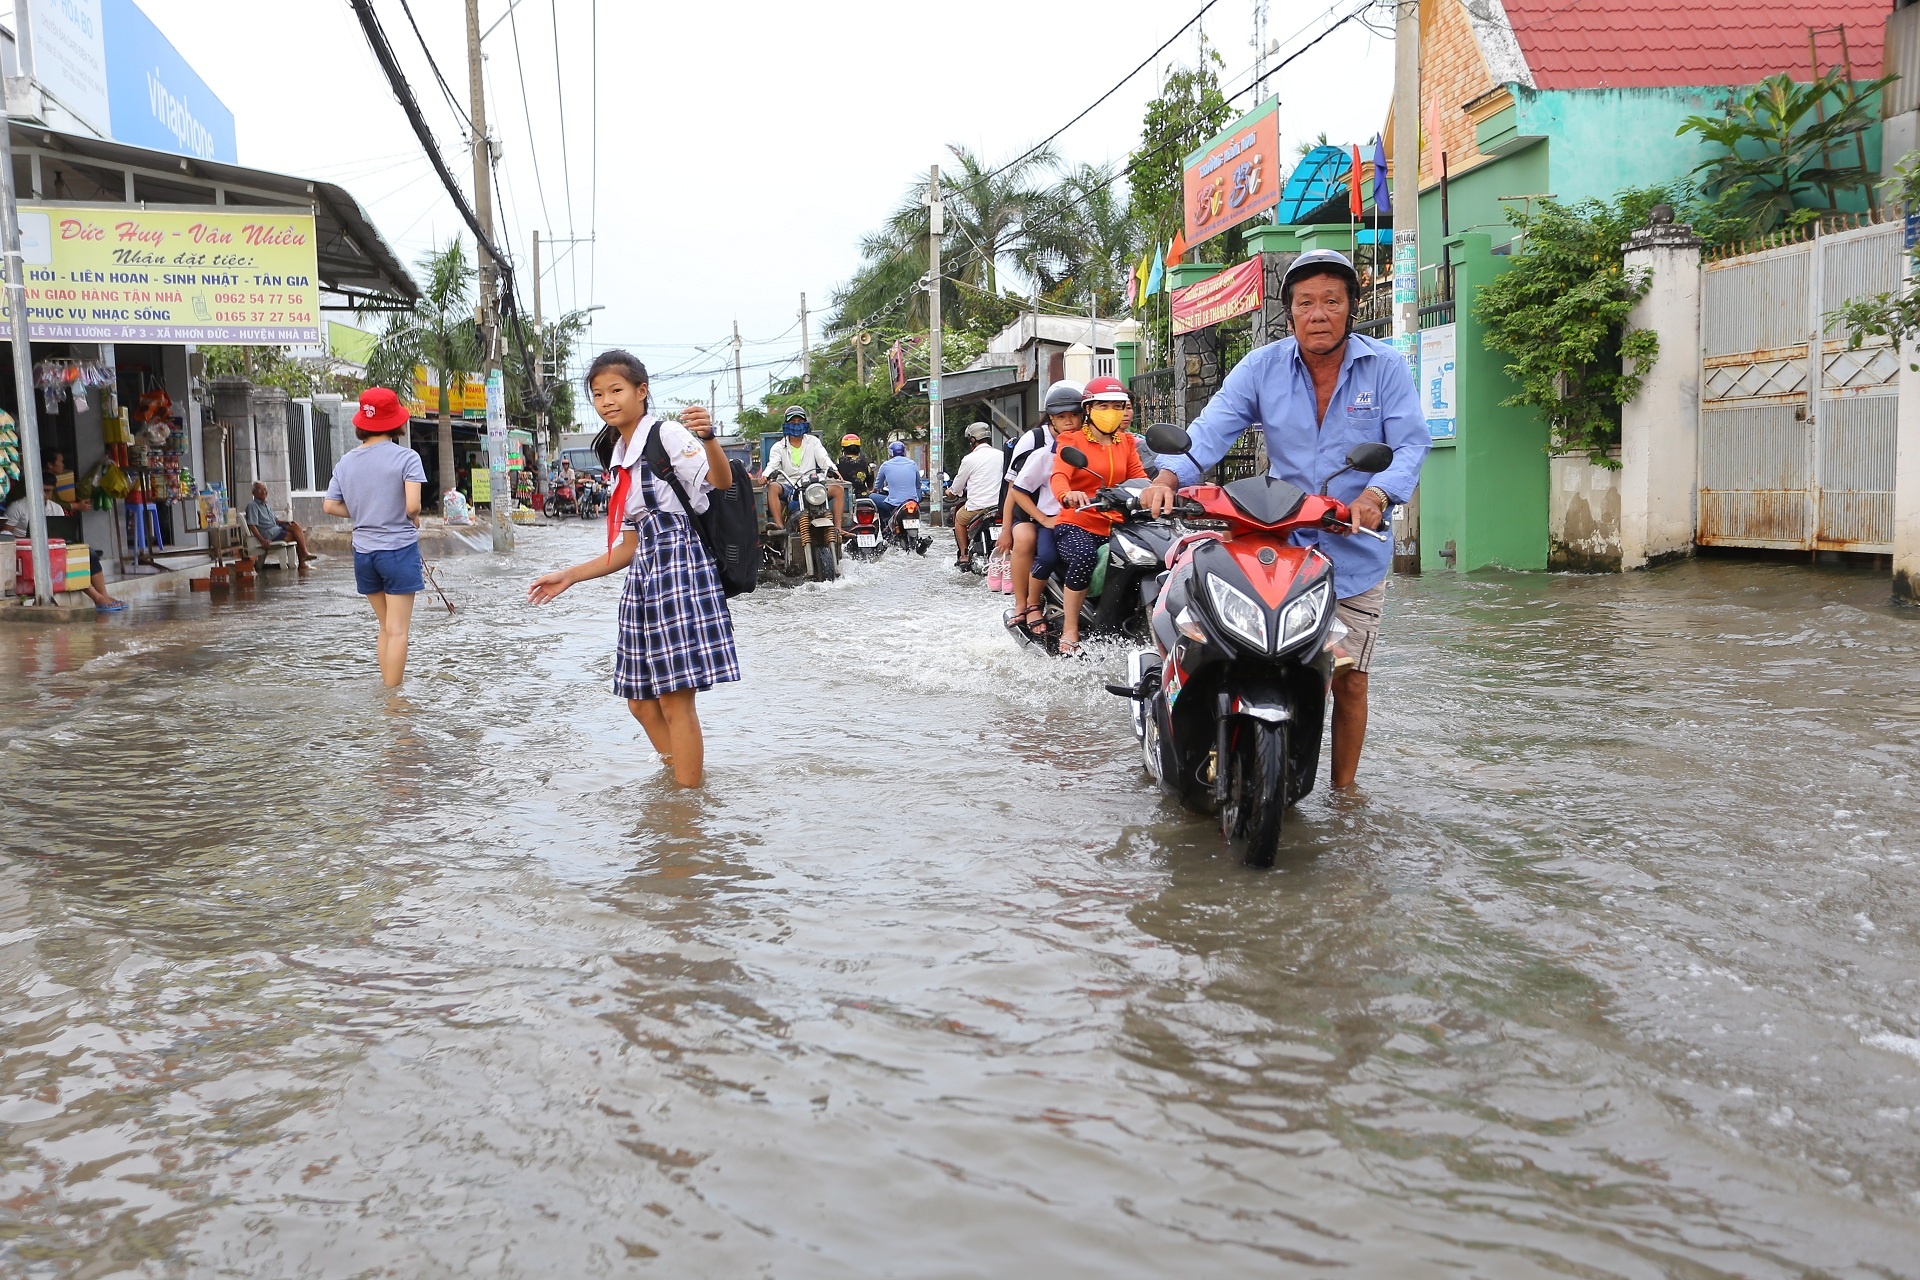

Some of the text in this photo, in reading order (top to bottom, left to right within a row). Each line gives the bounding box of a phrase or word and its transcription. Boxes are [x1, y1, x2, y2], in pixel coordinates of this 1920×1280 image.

[146, 65, 215, 160] vinaphone
[59, 219, 106, 241] Đức
[114, 221, 164, 248] Huy
[187, 223, 233, 245] Vân
[241, 224, 306, 246] Nhiều
[112, 248, 167, 267] Nhận
[173, 252, 206, 269] đặt
[30, 266, 56, 281] HỎI
[71, 269, 105, 283] LIÊN
[109, 272, 149, 284] HOAN
[163, 273, 196, 285] SINH
[201, 272, 239, 288] NHẬT
[253, 272, 282, 287] TÂN
[286, 275, 309, 287] GIA
[44, 289, 77, 301] GIAO
[81, 287, 119, 301] HÀNG
[123, 288, 151, 305] TẬN
[155, 289, 183, 303] NHÀ
[214, 293, 303, 305] 0962 54 77 56
[68, 308, 87, 323] VỤ
[92, 308, 130, 323] NHẠC
[134, 305, 171, 321] SỐNG
[215, 311, 312, 323] 0165 37 27 544
[31, 325, 46, 336] LÊ
[49, 325, 72, 337] VĂN
[75, 325, 111, 337] LƯƠNG
[121, 324, 137, 338] ẤP
[139, 327, 147, 338] 3
[157, 325, 171, 338] XÃ
[174, 327, 204, 339] NHƠN
[207, 326, 230, 339] ĐỨC
[239, 326, 275, 341] HUYỆN
[278, 328, 300, 340] NHÀ
